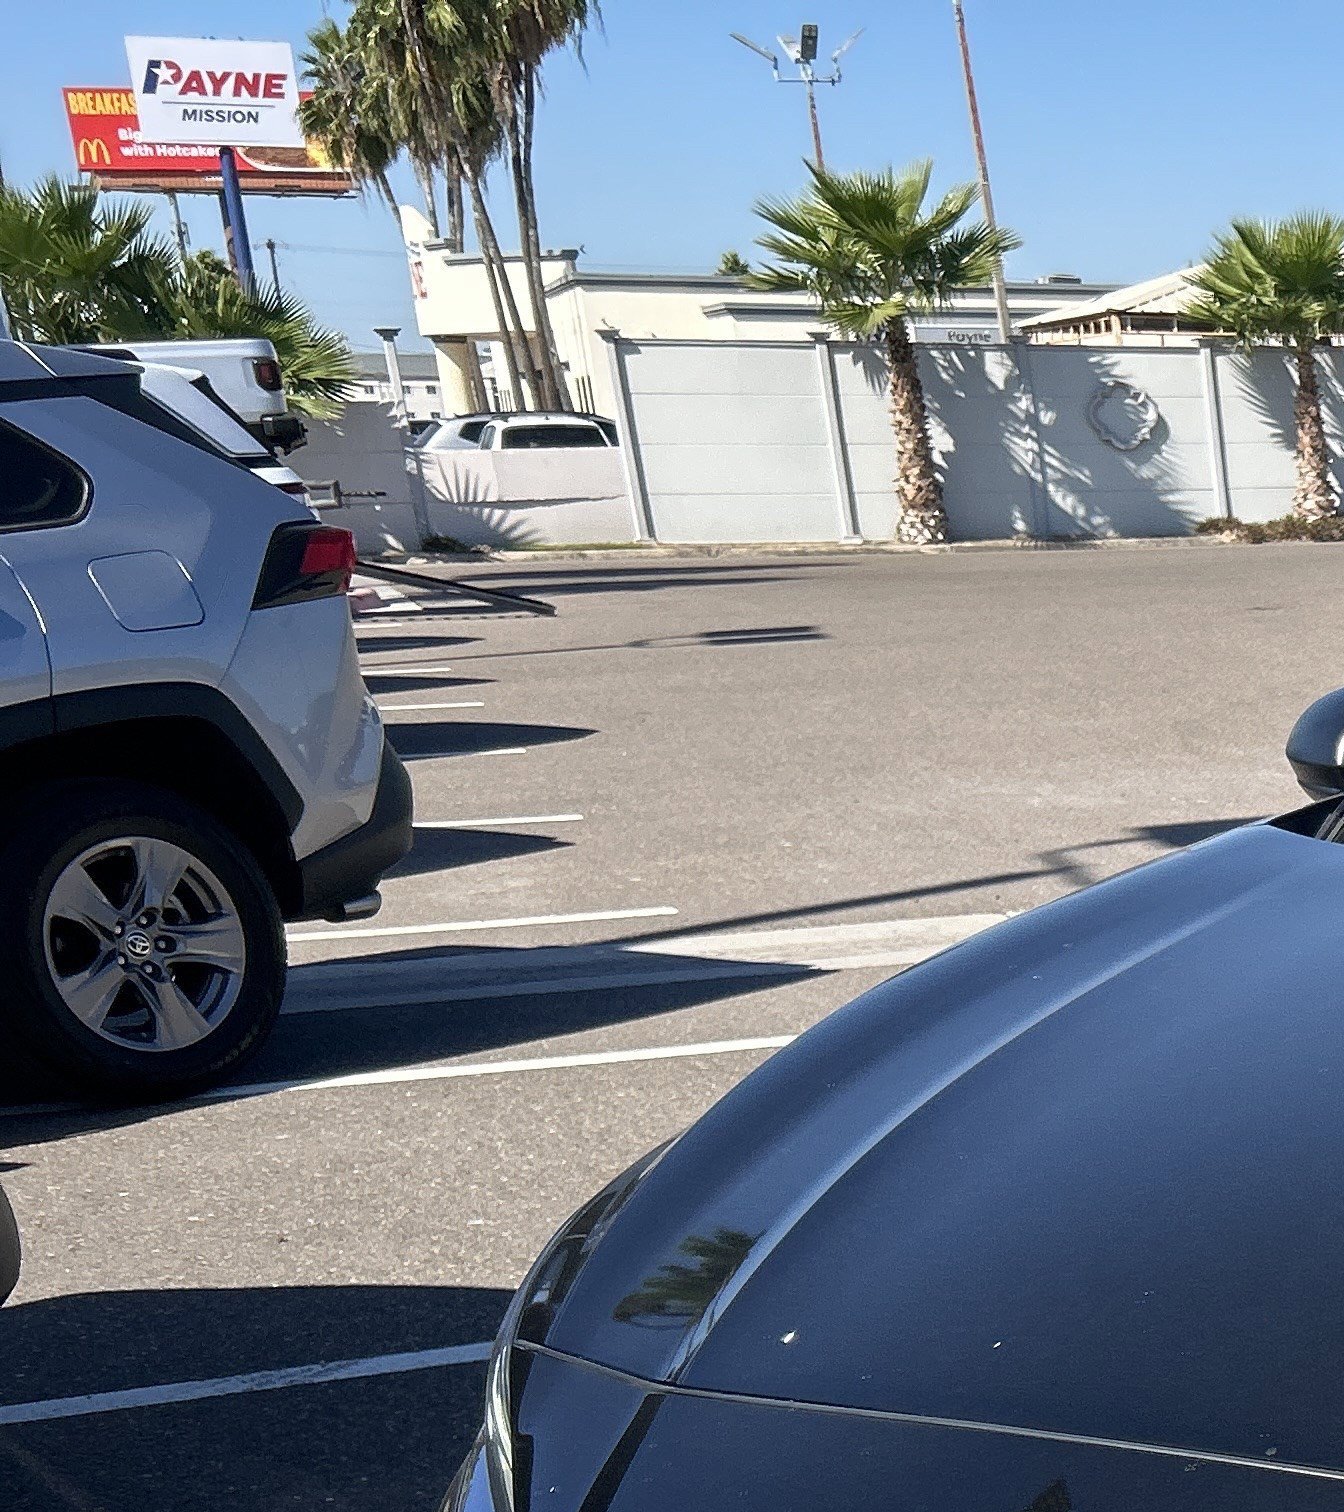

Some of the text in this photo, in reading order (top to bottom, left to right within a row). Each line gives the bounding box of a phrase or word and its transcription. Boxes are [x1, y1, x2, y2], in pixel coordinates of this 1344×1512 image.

[143, 59, 288, 99] PAYNE
[182, 108, 259, 124] MISSION
[119, 143, 154, 157] with
